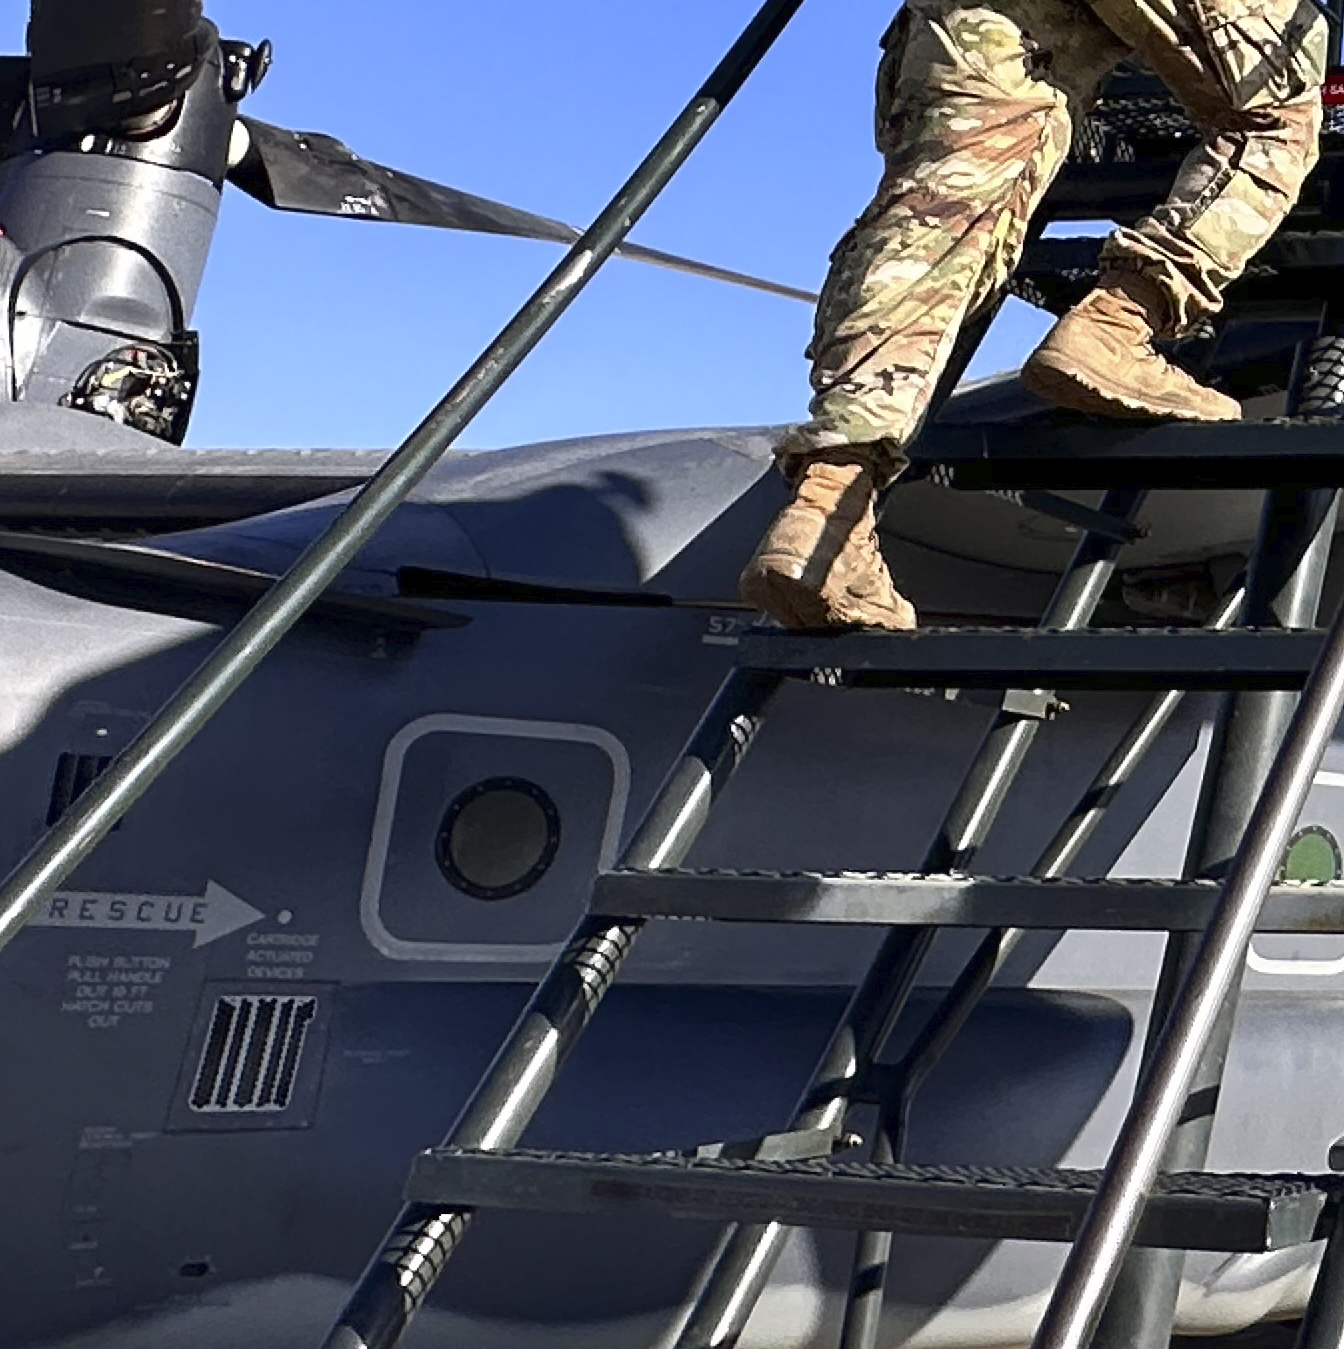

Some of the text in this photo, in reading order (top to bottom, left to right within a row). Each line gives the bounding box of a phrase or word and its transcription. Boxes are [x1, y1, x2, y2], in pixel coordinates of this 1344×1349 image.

[50, 897, 207, 923] RESCUE
[247, 934, 319, 946] CARTRIDGE
[66, 955, 171, 969] PUSH BUTTON
[247, 951, 313, 962] ACTUATED
[67, 971, 164, 983] PULL HANDLE
[248, 966, 303, 978] DEVICES
[88, 1015, 120, 1028] OUT
